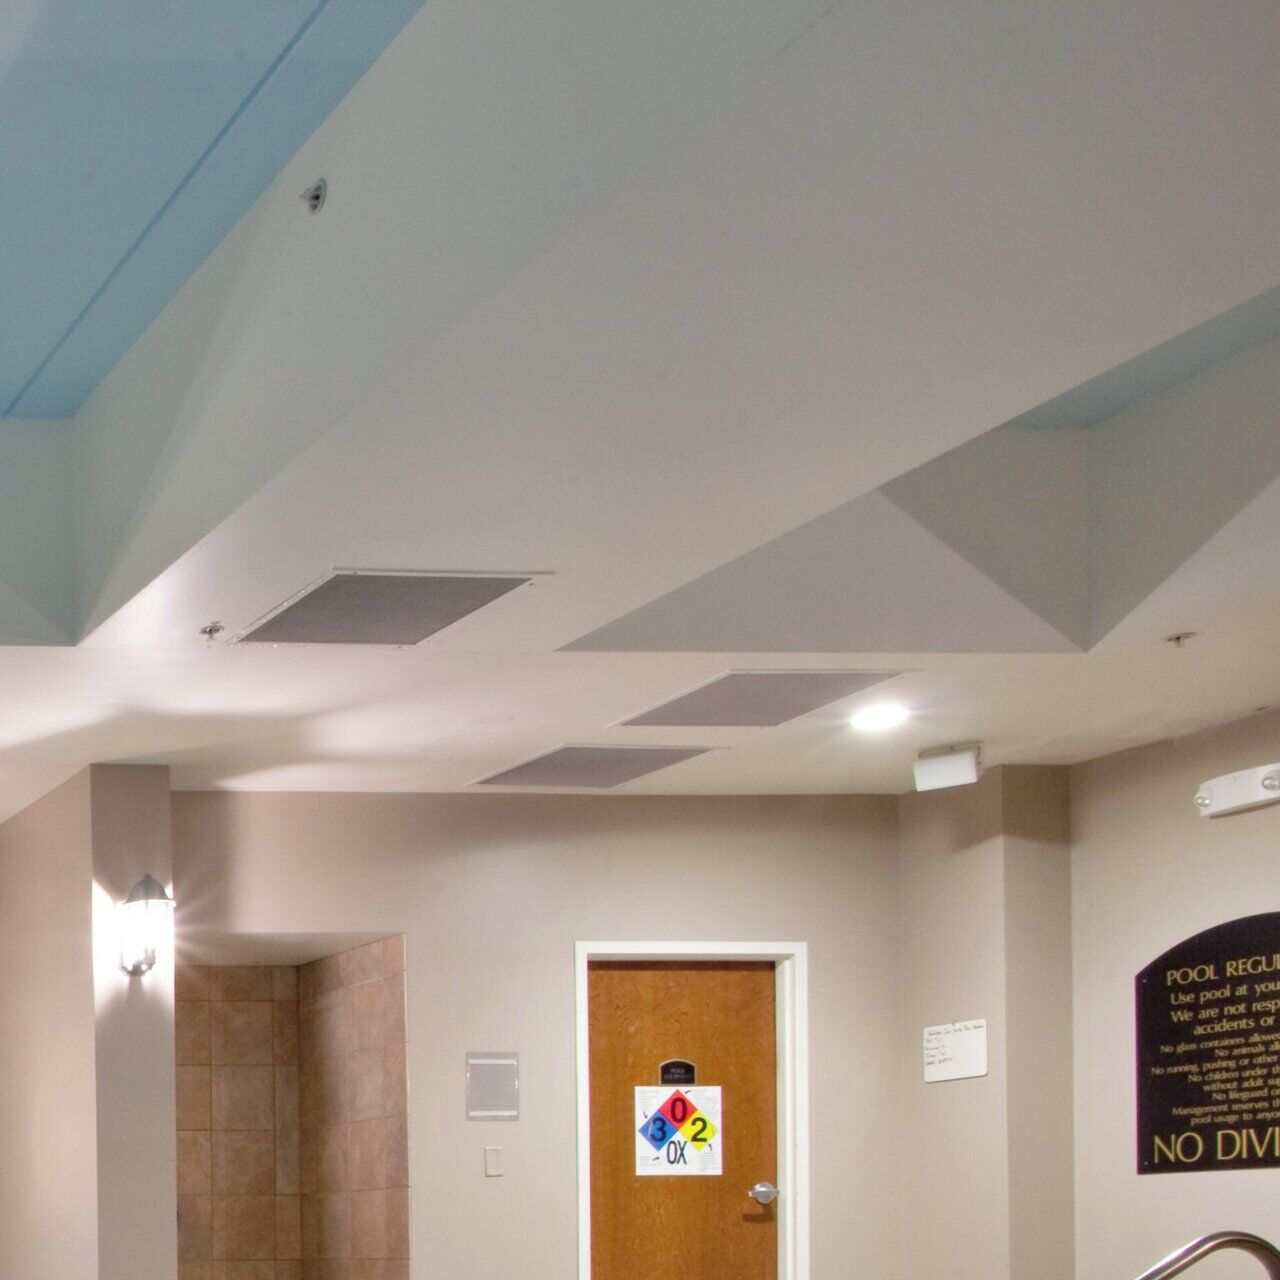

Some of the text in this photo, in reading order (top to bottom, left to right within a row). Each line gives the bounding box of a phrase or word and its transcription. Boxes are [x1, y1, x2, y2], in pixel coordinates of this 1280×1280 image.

[1166, 964, 1219, 986] POOL
[1171, 993, 1195, 1005] Use
[1200, 984, 1231, 1004] pool
[1235, 984, 1248, 996] at
[1171, 1011, 1193, 1023] We
[1198, 1008, 1219, 1019] are
[1224, 1003, 1247, 1016] not
[1194, 1016, 1276, 1035] accidents or
[1160, 1045, 1174, 1054] No
[1177, 1042, 1197, 1054] glass
[1200, 1037, 1245, 1049] containers
[1214, 1049, 1229, 1057] No
[1232, 1045, 1265, 1055] animals
[1151, 1067, 1165, 1076] No
[1203, 1060, 1237, 1071] pushing
[1239, 1058, 1250, 1066] or
[1253, 1055, 1278, 1064] other
[1188, 1074, 1202, 1083] No
[1205, 1071, 1239, 1081] children
[1241, 1067, 1268, 1077] under
[1203, 1081, 1237, 1091] without
[1241, 1079, 1264, 1088] adult
[1212, 1092, 1227, 1101] No
[1229, 1088, 1268, 1100] lifeguard
[670, 1097, 688, 1123] 0
[1172, 1104, 1228, 1116] Management
[1232, 1101, 1269, 1111] reserves
[1191, 1115, 1211, 1126] pool
[1214, 1114, 1239, 1124] usage
[1242, 1112, 1253, 1120] to
[650, 1117, 707, 1143] 3 2
[666, 1140, 688, 1165] OX
[1153, 1132, 1204, 1164] NO
